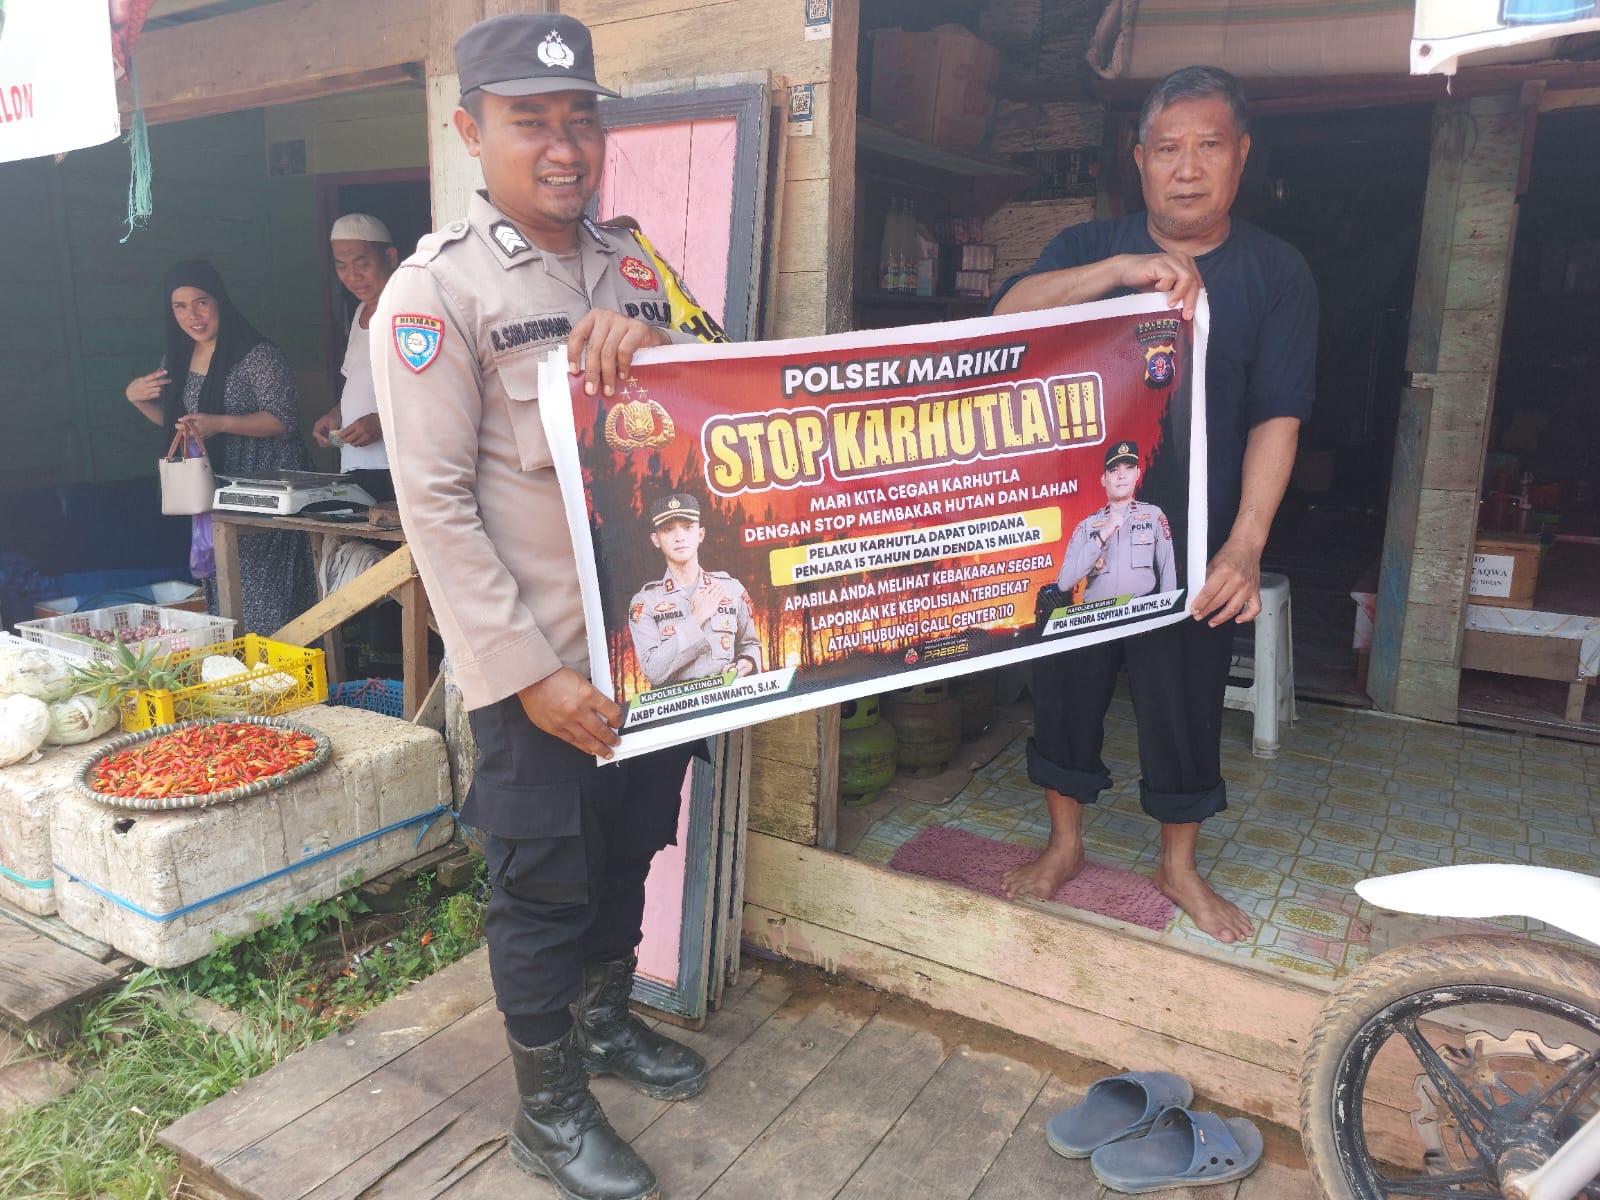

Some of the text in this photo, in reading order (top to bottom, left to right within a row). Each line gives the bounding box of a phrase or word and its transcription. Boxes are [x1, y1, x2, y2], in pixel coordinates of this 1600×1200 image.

[0, 83, 33, 123] LON
[785, 345, 1026, 395] POLSEK MARIKIT
[711, 381, 1098, 487] STOP KARHUTLA !!!
[744, 479, 1078, 542] DENGAN STOP MEMBAKAR HUTAN DAN LAHAN
[810, 468, 1020, 512] MARI KITA CEGAH KARHUTLA
[795, 529, 1041, 579] PENJARA 15 TAHUN DAN DENDA 15 MILYAR
[809, 516, 1025, 560] PELAKU KARHUTLA DAPAT DIPIDANA
[784, 553, 1053, 611] APABILA ANDA MELIHAT KEBAKARAN SEGERA
[811, 579, 1030, 631] LAPORKAN KE KEPOLISIAN TERDEKAT
[828, 632, 860, 652] ATAU
[862, 621, 919, 645] HUBUNGI
[921, 613, 950, 634] CALL
[952, 607, 997, 628] CENTER
[998, 604, 1014, 618] 110
[1069, 613, 1096, 627] HENDRA
[924, 643, 969, 660] PRESISI
[630, 707, 655, 723] AKBP
[657, 697, 700, 716] CHANDRA
[701, 685, 757, 705] ISMAWANTO,
[640, 677, 724, 704] KAPOLRES KATINGAN
